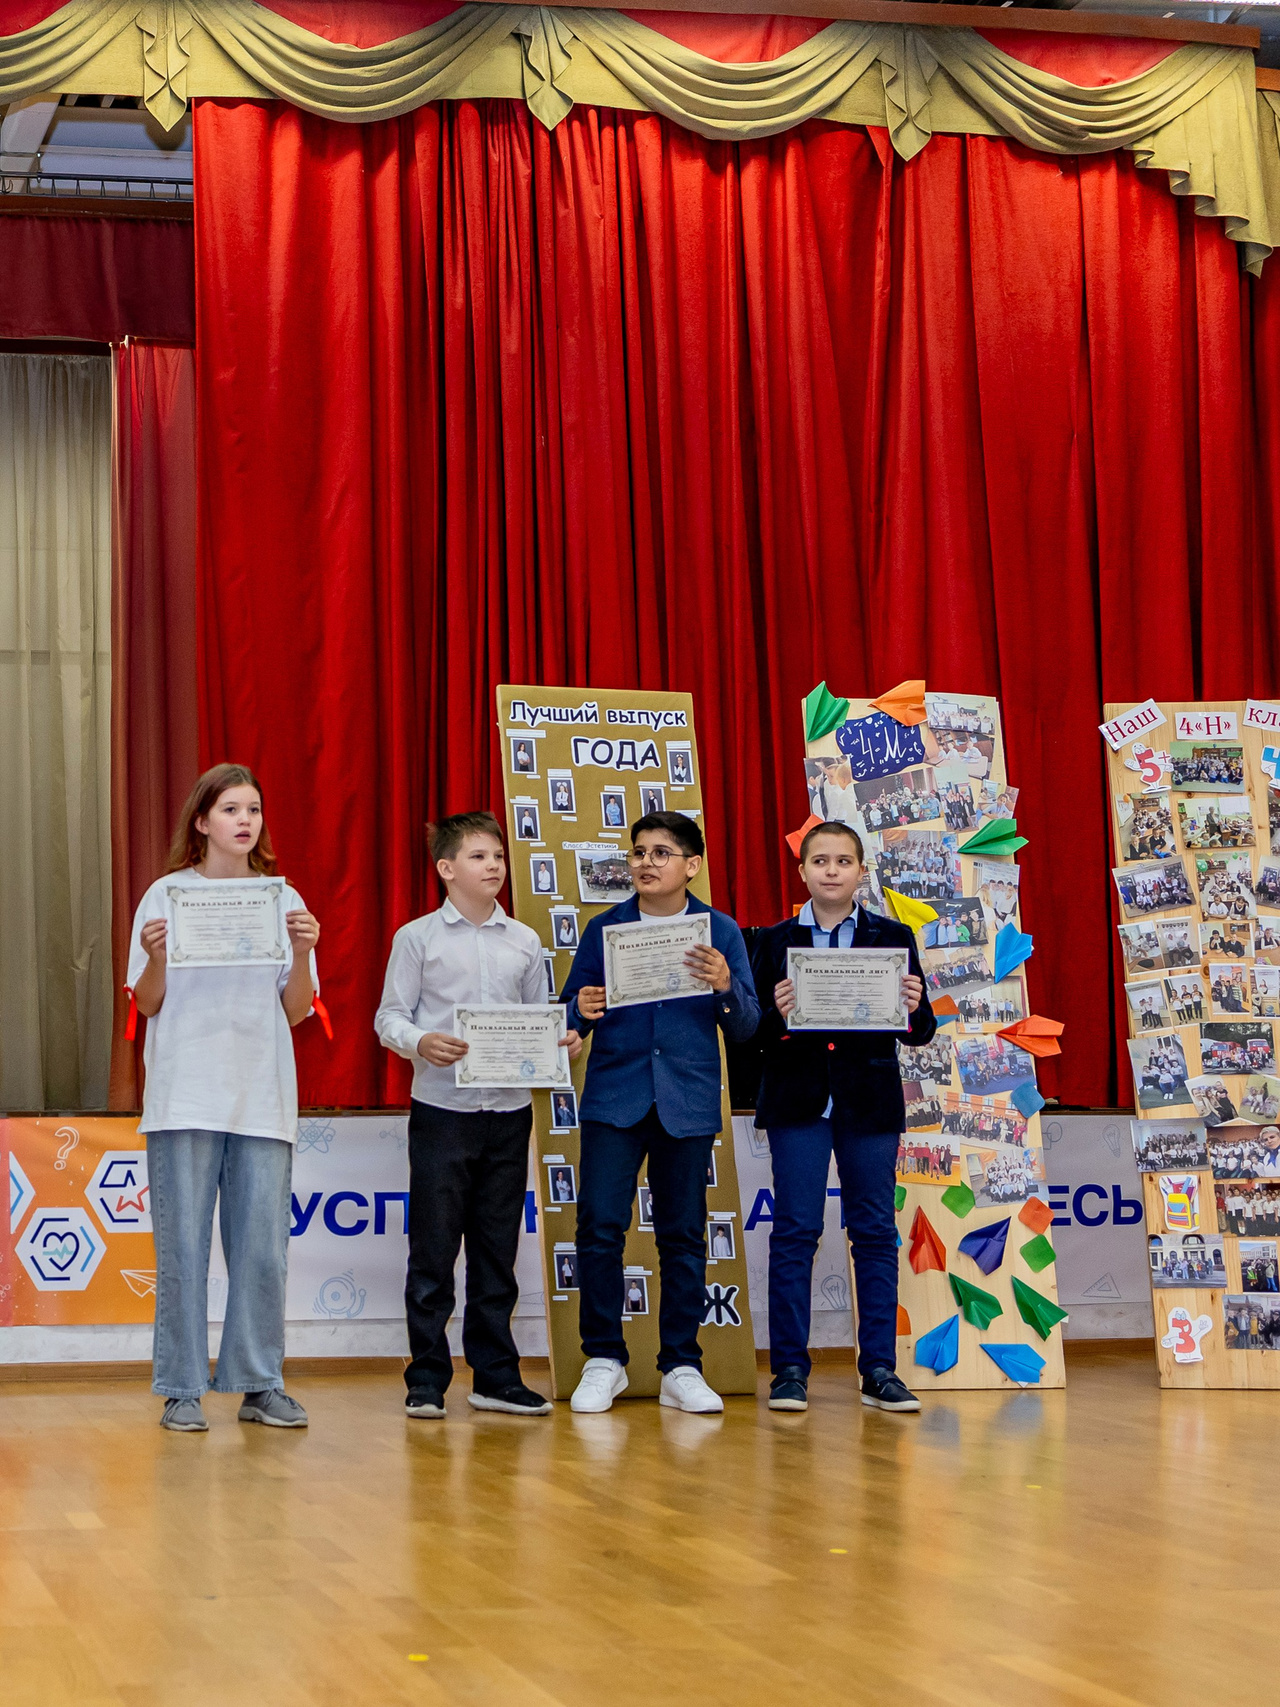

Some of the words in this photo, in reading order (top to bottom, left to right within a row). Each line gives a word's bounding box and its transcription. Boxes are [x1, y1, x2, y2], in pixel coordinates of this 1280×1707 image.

[511, 701, 598, 726] Лучший
[607, 710, 686, 731] выпуск
[1105, 707, 1158, 743] Наш
[1179, 716, 1231, 736] 4«Н»
[1248, 707, 1280, 727] кл
[573, 738, 660, 771] ГОДА
[290, 1191, 410, 1236] УСП
[1048, 1184, 1143, 1227] ЕСЬ
